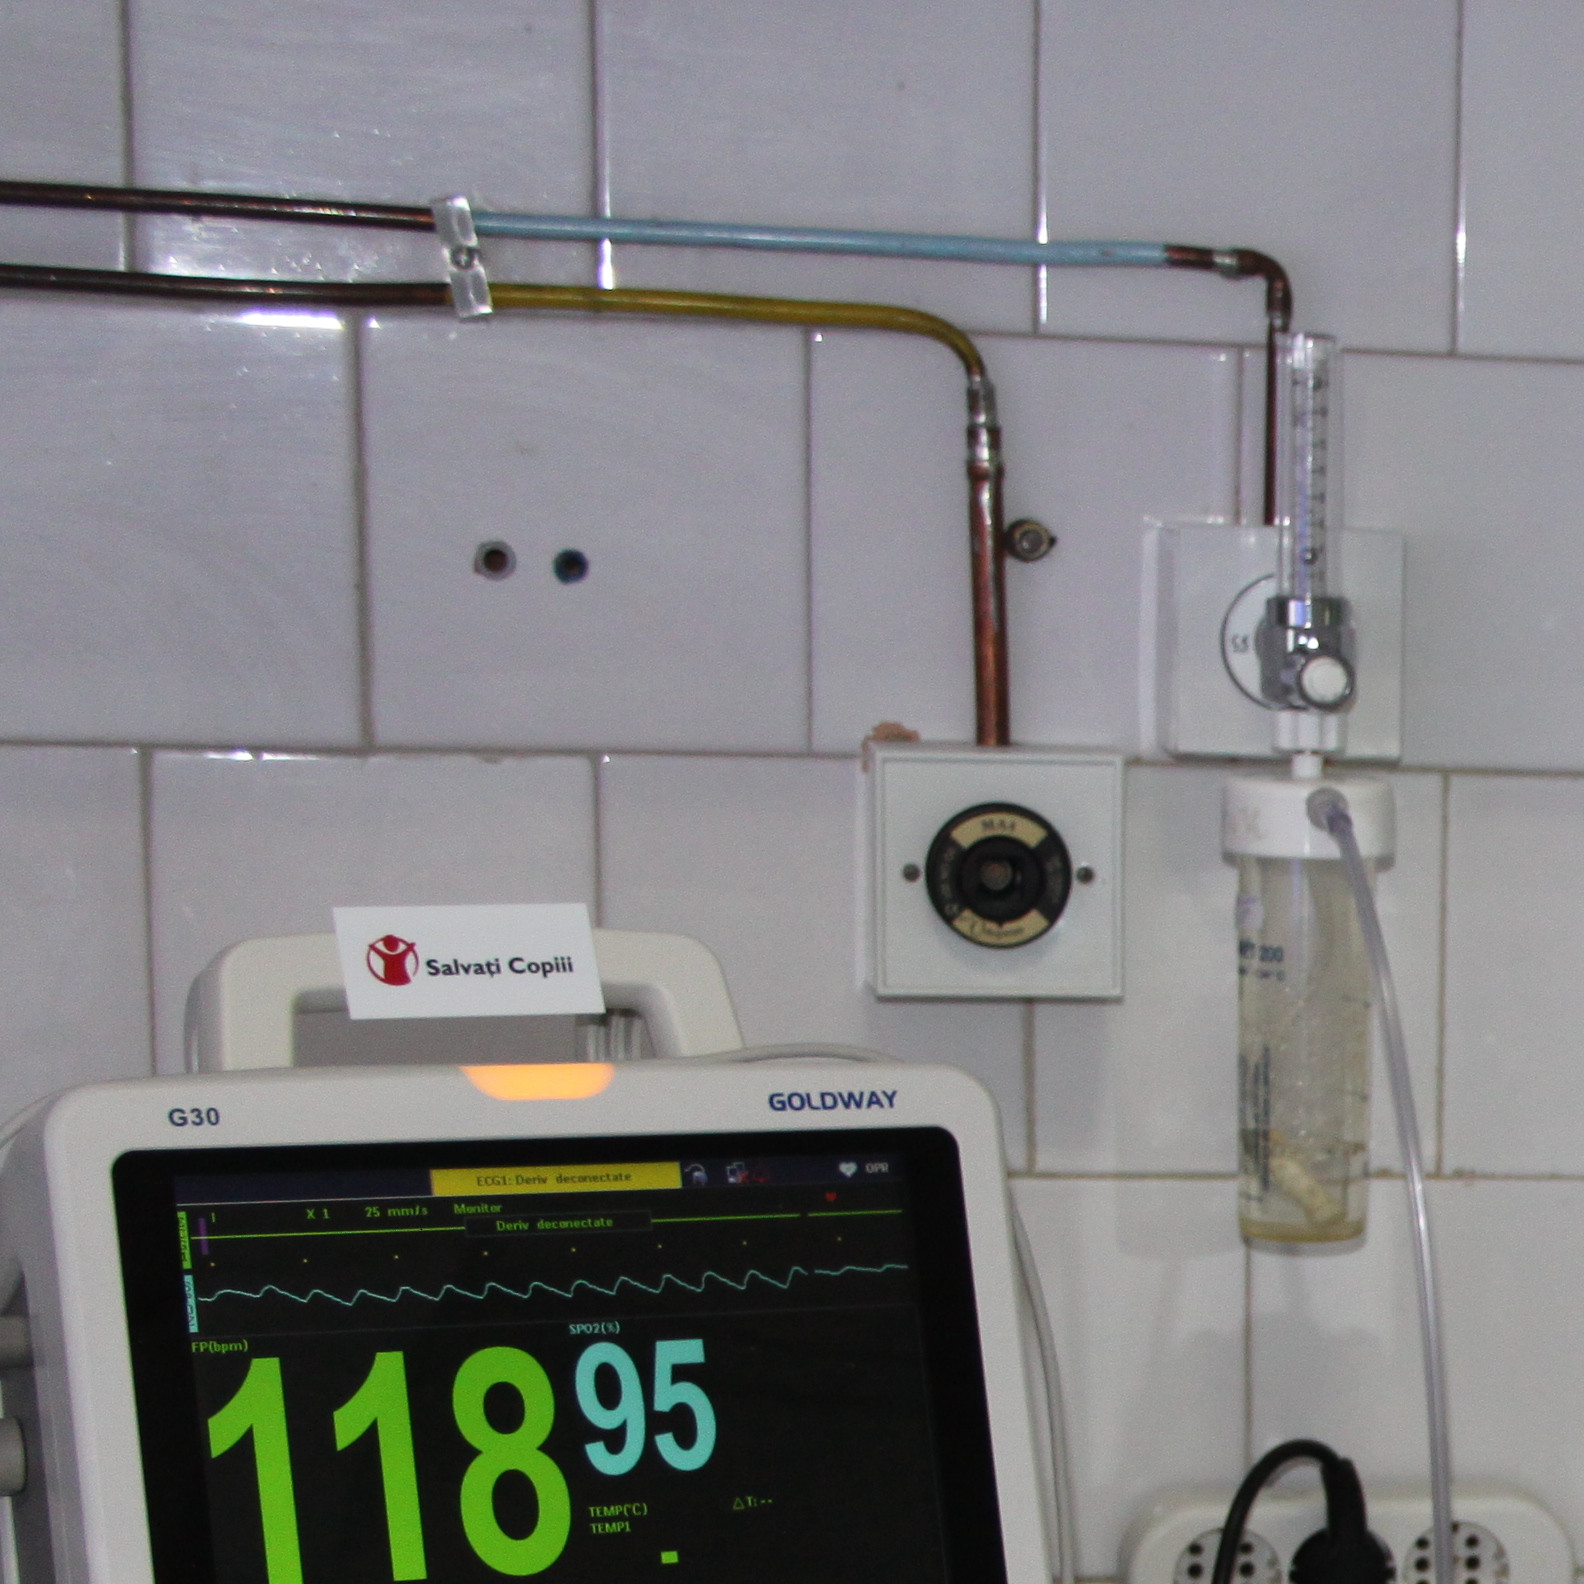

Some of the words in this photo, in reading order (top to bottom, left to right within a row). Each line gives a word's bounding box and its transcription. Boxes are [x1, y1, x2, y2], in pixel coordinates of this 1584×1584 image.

[426, 958, 501, 978] Salvați
[508, 956, 574, 979] Copiii
[768, 1090, 898, 1111] GOLDWAY
[168, 1107, 220, 1127] G30
[556, 1172, 632, 1184] deconectate
[453, 1203, 503, 1215] Monitor
[537, 1217, 614, 1230] deconectate
[574, 1338, 717, 1476] 95
[590, 1521, 631, 1534] TEMP1
